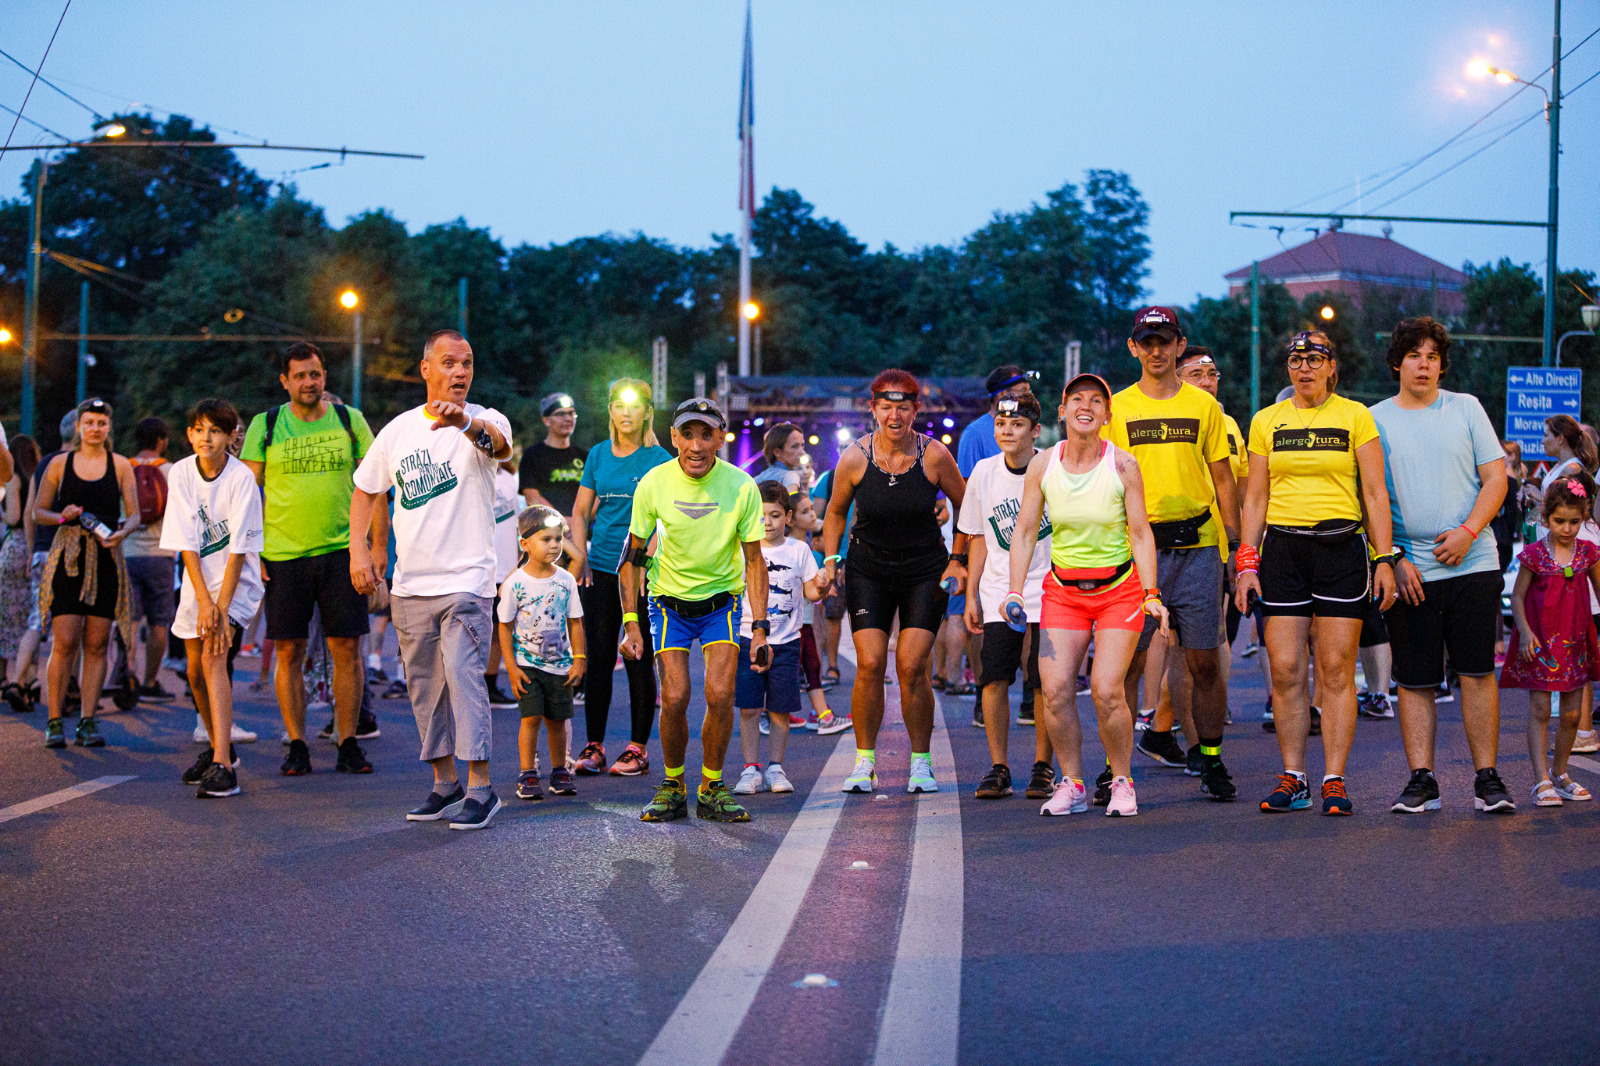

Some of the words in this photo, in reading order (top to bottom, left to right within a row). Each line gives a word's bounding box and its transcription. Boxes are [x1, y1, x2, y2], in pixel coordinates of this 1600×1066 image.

[1526, 372, 1543, 386] Alte
[1546, 372, 1578, 389] Direcții
[1518, 393, 1552, 411] Reșița
[1514, 417, 1545, 431] Morav
[1516, 439, 1545, 454] Buzia
[400, 448, 432, 475] STRĂZI
[992, 497, 1021, 523] STRĂZI
